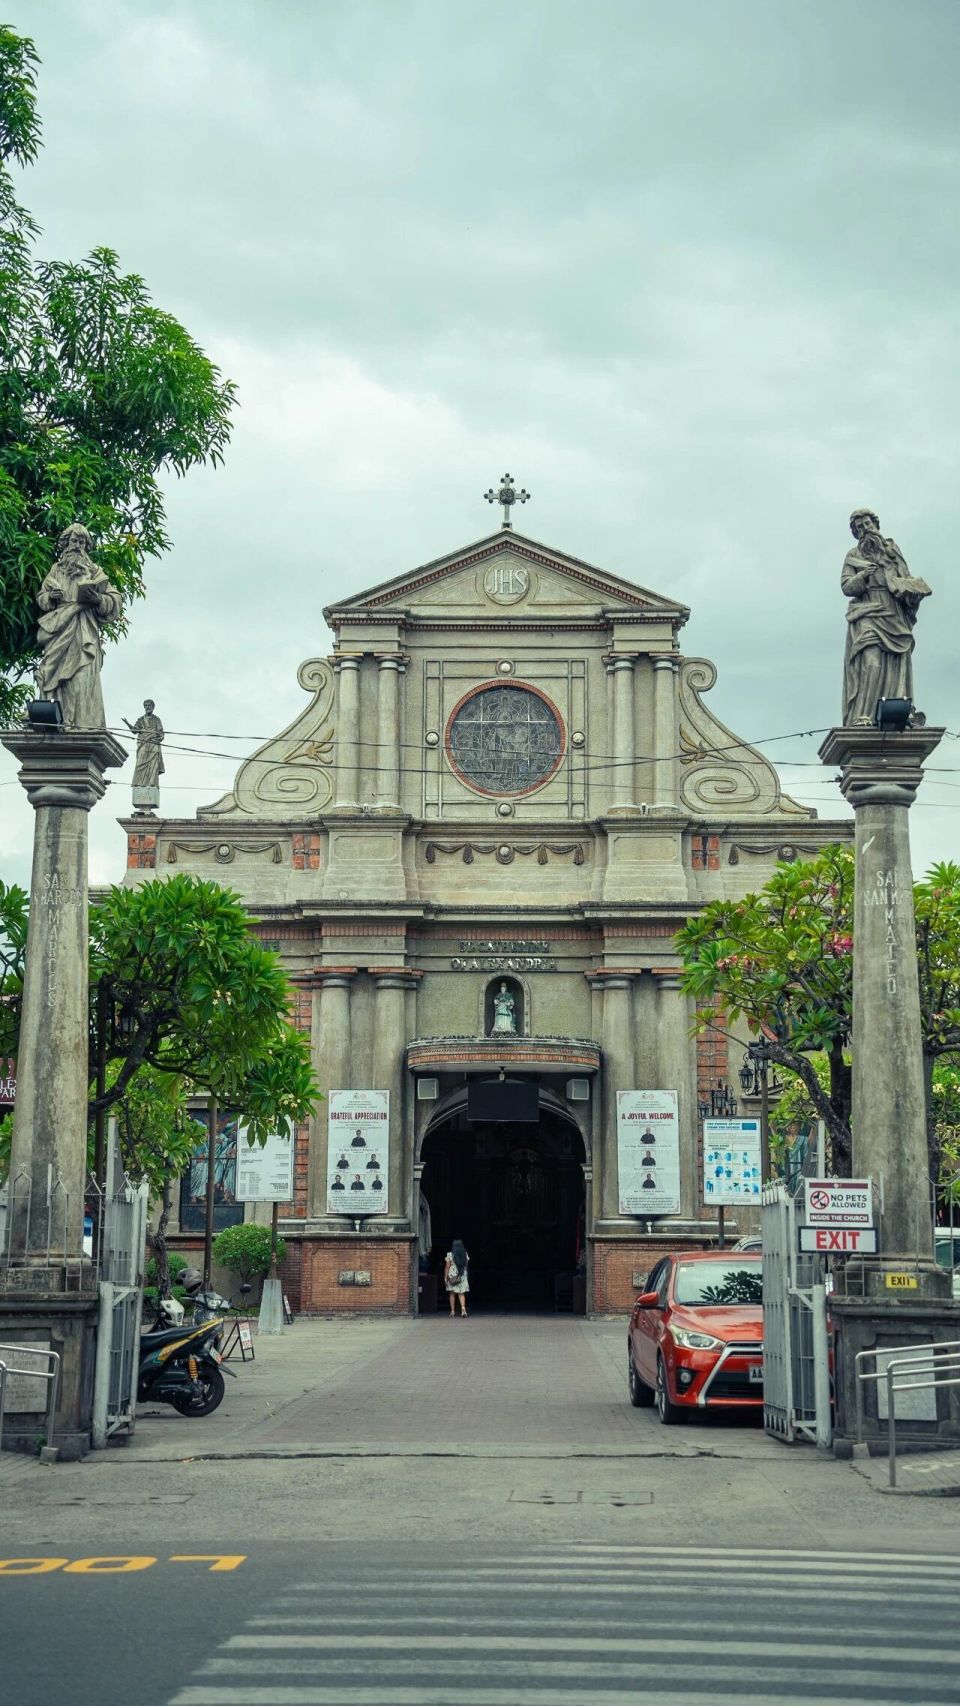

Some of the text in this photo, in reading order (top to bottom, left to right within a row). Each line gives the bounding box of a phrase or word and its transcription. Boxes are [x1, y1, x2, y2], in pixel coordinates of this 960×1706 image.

[486, 569, 528, 595] JHS
[885, 908, 897, 994] MATEO
[331, 1112, 387, 1120] GRATEFUL APPRECIATION
[846, 1194, 868, 1202] PETS
[816, 1231, 860, 1249] EXIT
